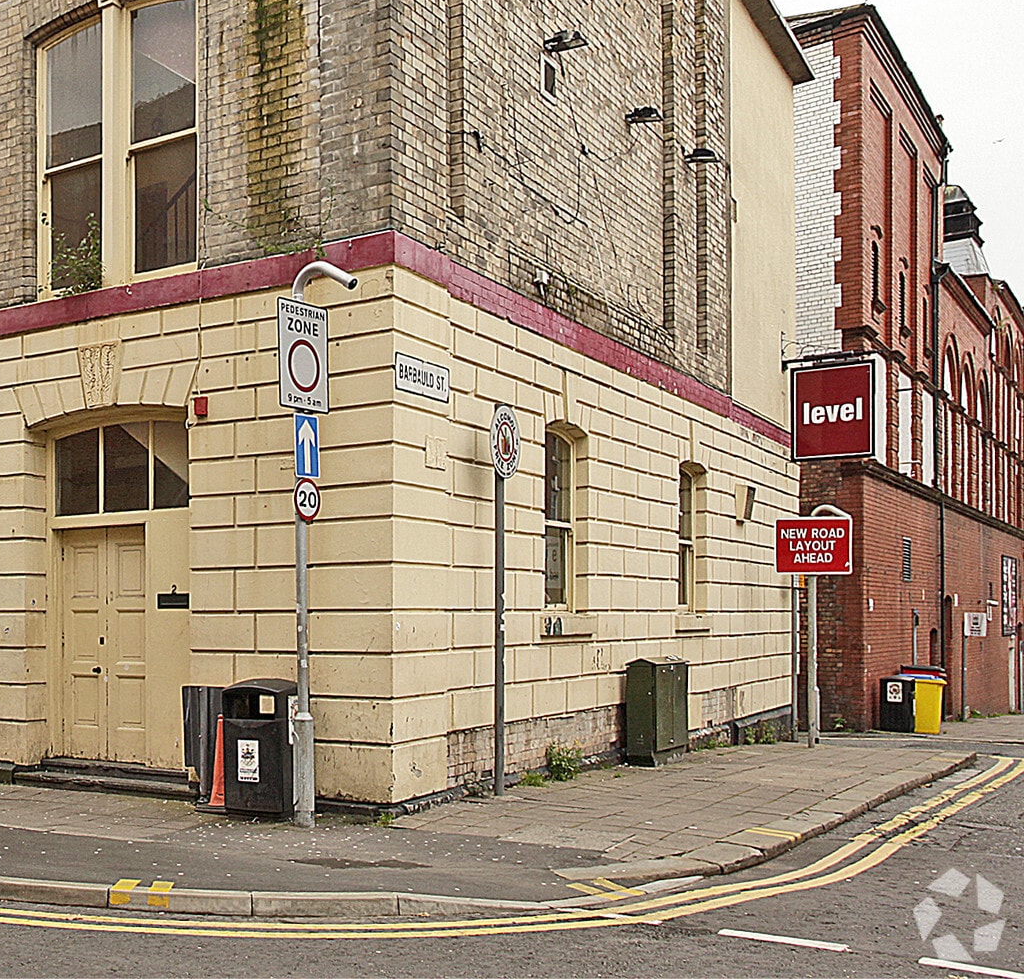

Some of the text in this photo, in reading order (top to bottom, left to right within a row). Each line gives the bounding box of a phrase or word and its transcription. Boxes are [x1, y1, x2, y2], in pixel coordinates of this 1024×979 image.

[281, 302, 325, 322] PEDESTRIAN
[287, 317, 319, 338] ZONE
[399, 363, 447, 392] BARBAULD ST.
[803, 396, 863, 425] level
[494, 412, 516, 431] ALCOHOL
[493, 444, 505, 470] FREE
[506, 448, 518, 471] ZONE
[298, 490, 317, 509] 20
[780, 528, 845, 540] NEW ROAD
[789, 540, 836, 552] LAYOUT
[793, 553, 833, 564] AHEAD
[171, 584, 177, 594] 2
